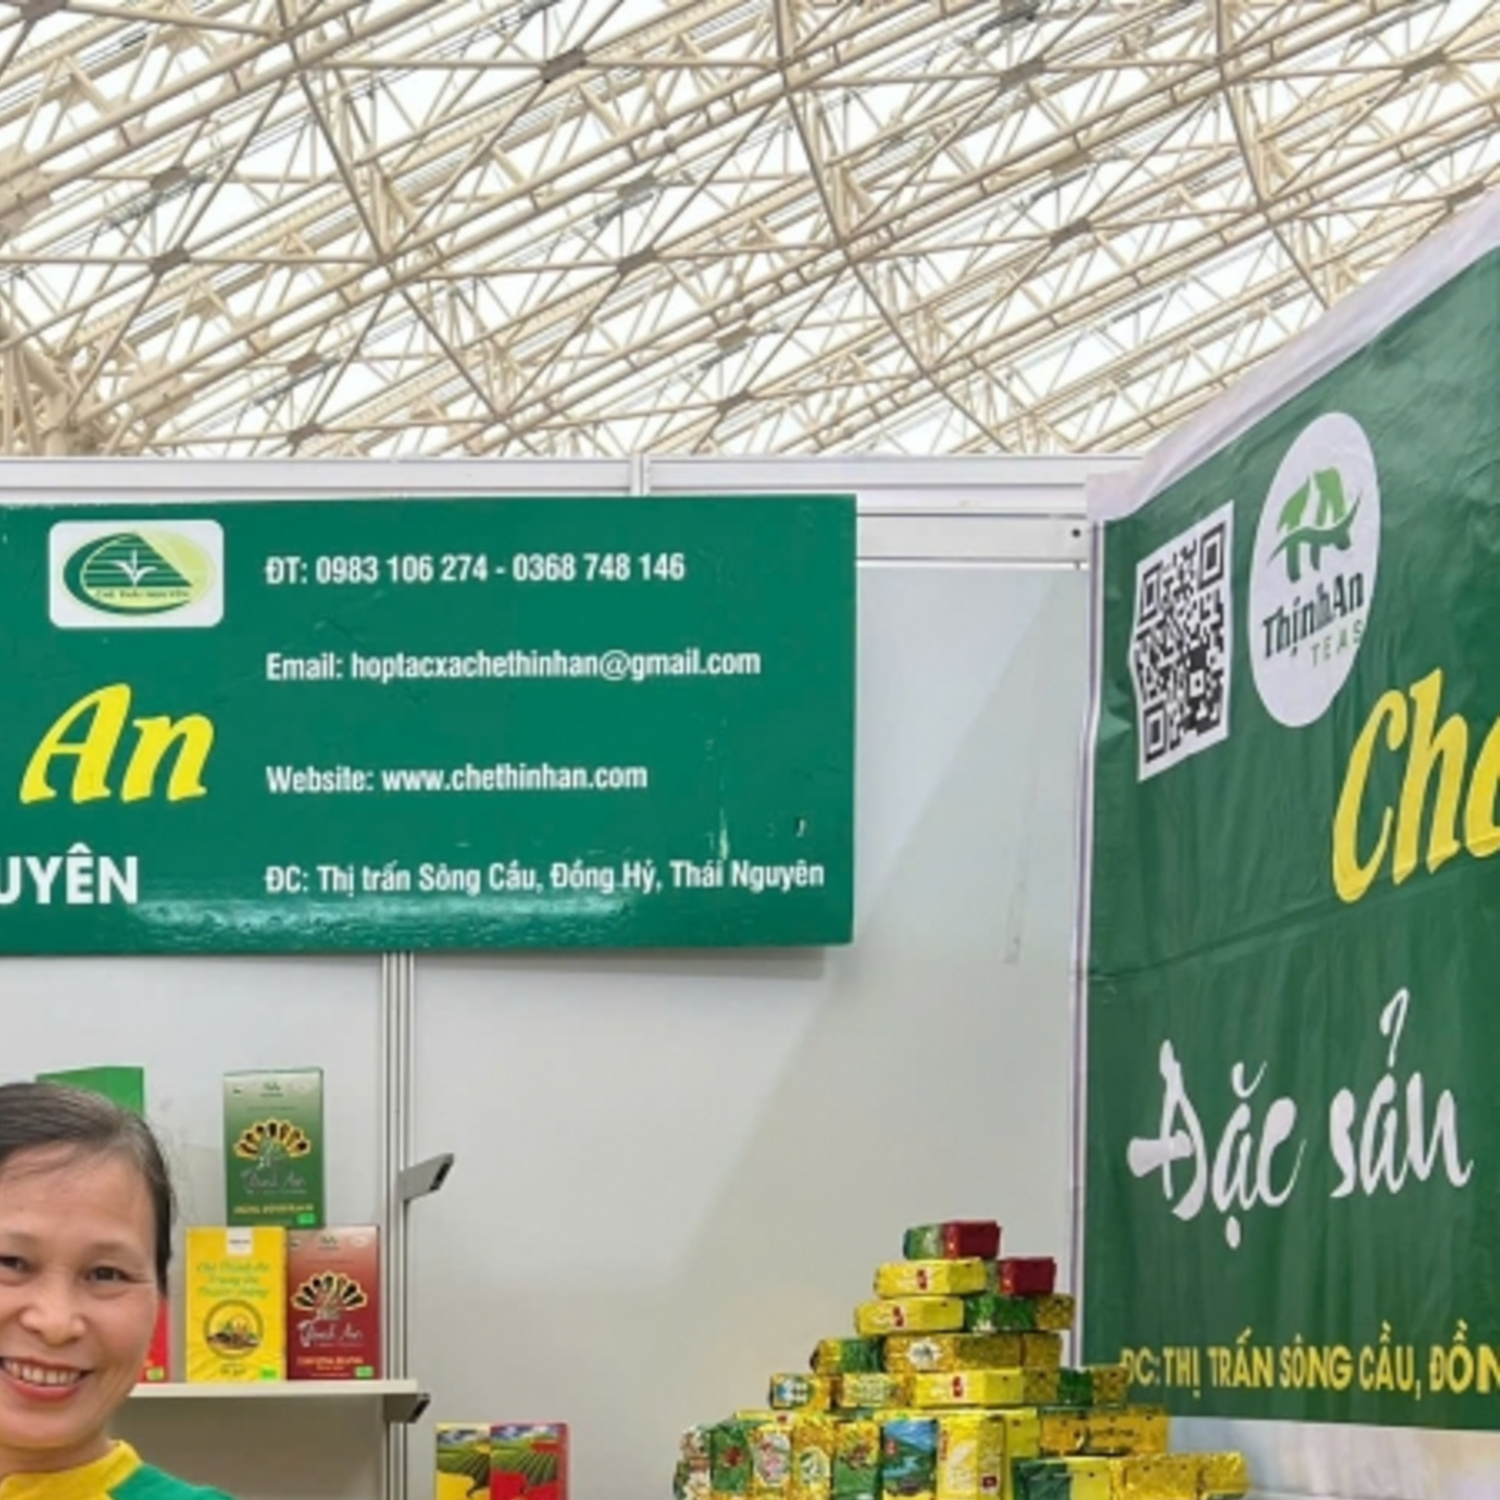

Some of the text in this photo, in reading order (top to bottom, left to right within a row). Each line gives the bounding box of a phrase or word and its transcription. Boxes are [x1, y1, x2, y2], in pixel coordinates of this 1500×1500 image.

[264, 556, 308, 585] ĐT:
[315, 555, 380, 584] 0983
[386, 555, 434, 583] 106
[440, 554, 489, 583] 274
[511, 554, 576, 583] 0368
[583, 553, 631, 582] 748
[637, 553, 686, 582] 146
[264, 648, 762, 684] Email: hoptacxachethinhan@gmail.com
[1311, 619, 1365, 668] TEAS
[19, 682, 216, 805] An
[264, 763, 649, 794] Website: www.chethinhan.com
[264, 864, 309, 894] ĐC:
[317, 864, 356, 899] Thị
[418, 860, 481, 898] Sông
[669, 857, 726, 889] Thái
[730, 857, 825, 894] Nguyên
[1126, 986, 1474, 1250] Đặc sản
[1163, 1346, 1201, 1399] THỊ
[1207, 1326, 1274, 1389] TRẤN
[1279, 1334, 1354, 1391] SÔNG
[1358, 1320, 1421, 1402] CẦU,
